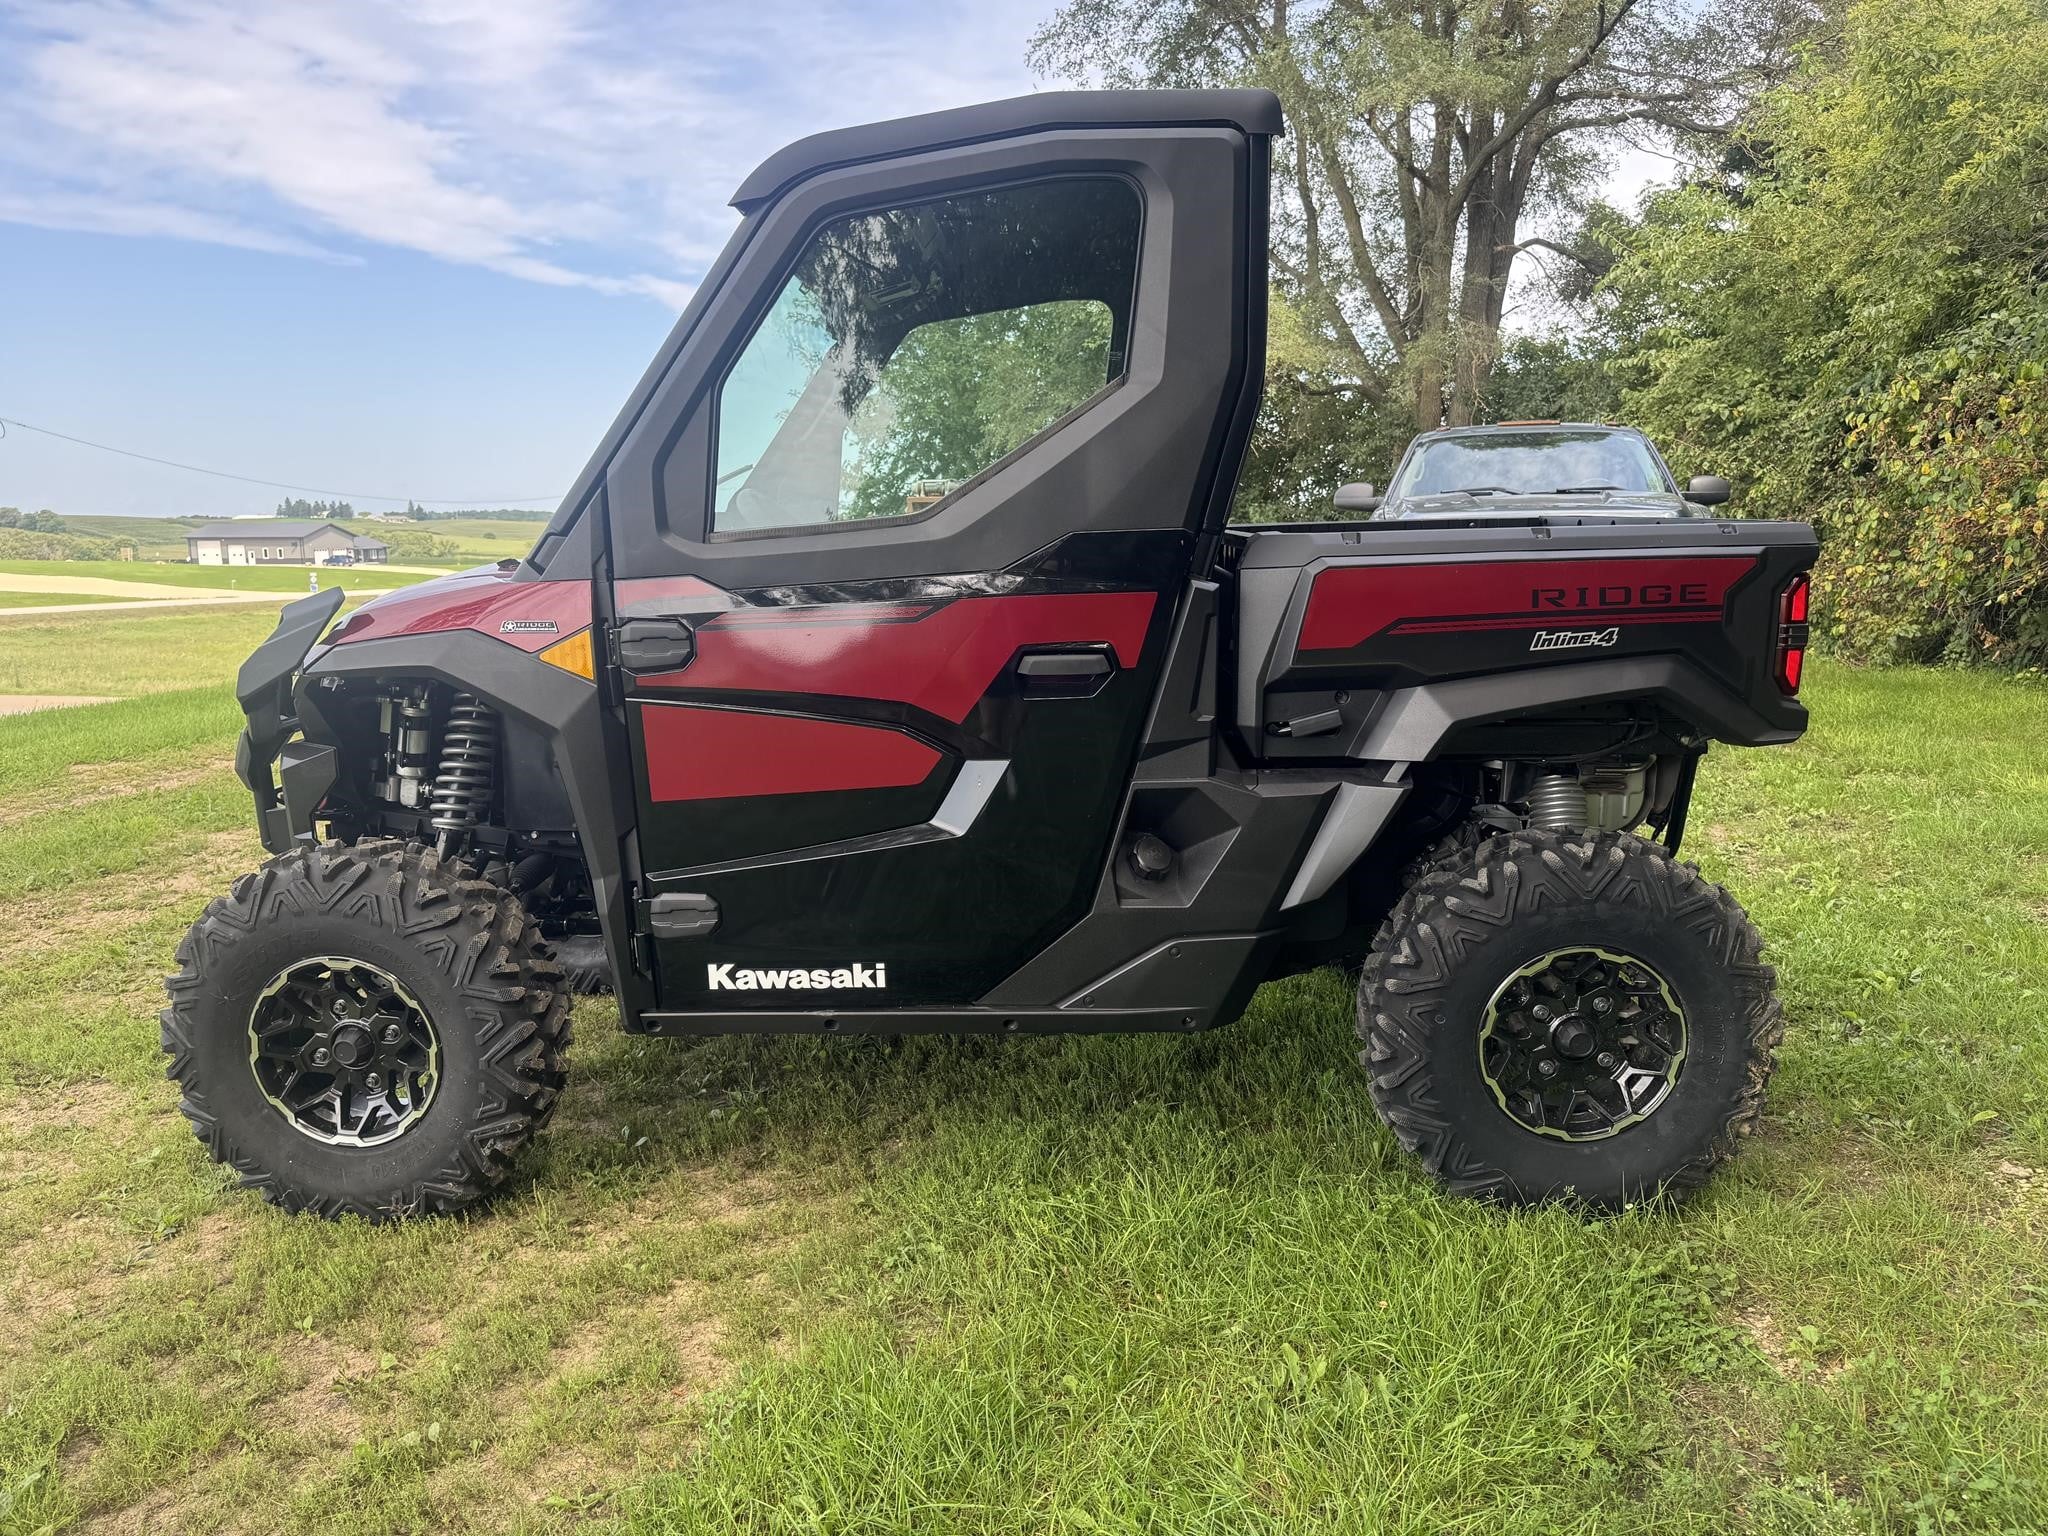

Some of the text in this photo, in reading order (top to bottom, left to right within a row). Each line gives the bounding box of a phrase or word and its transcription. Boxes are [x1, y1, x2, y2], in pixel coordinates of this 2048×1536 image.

[1531, 584, 1708, 608] RIDGE
[1530, 627, 1620, 651] Inline-4
[707, 962, 887, 990] Kawasaki
